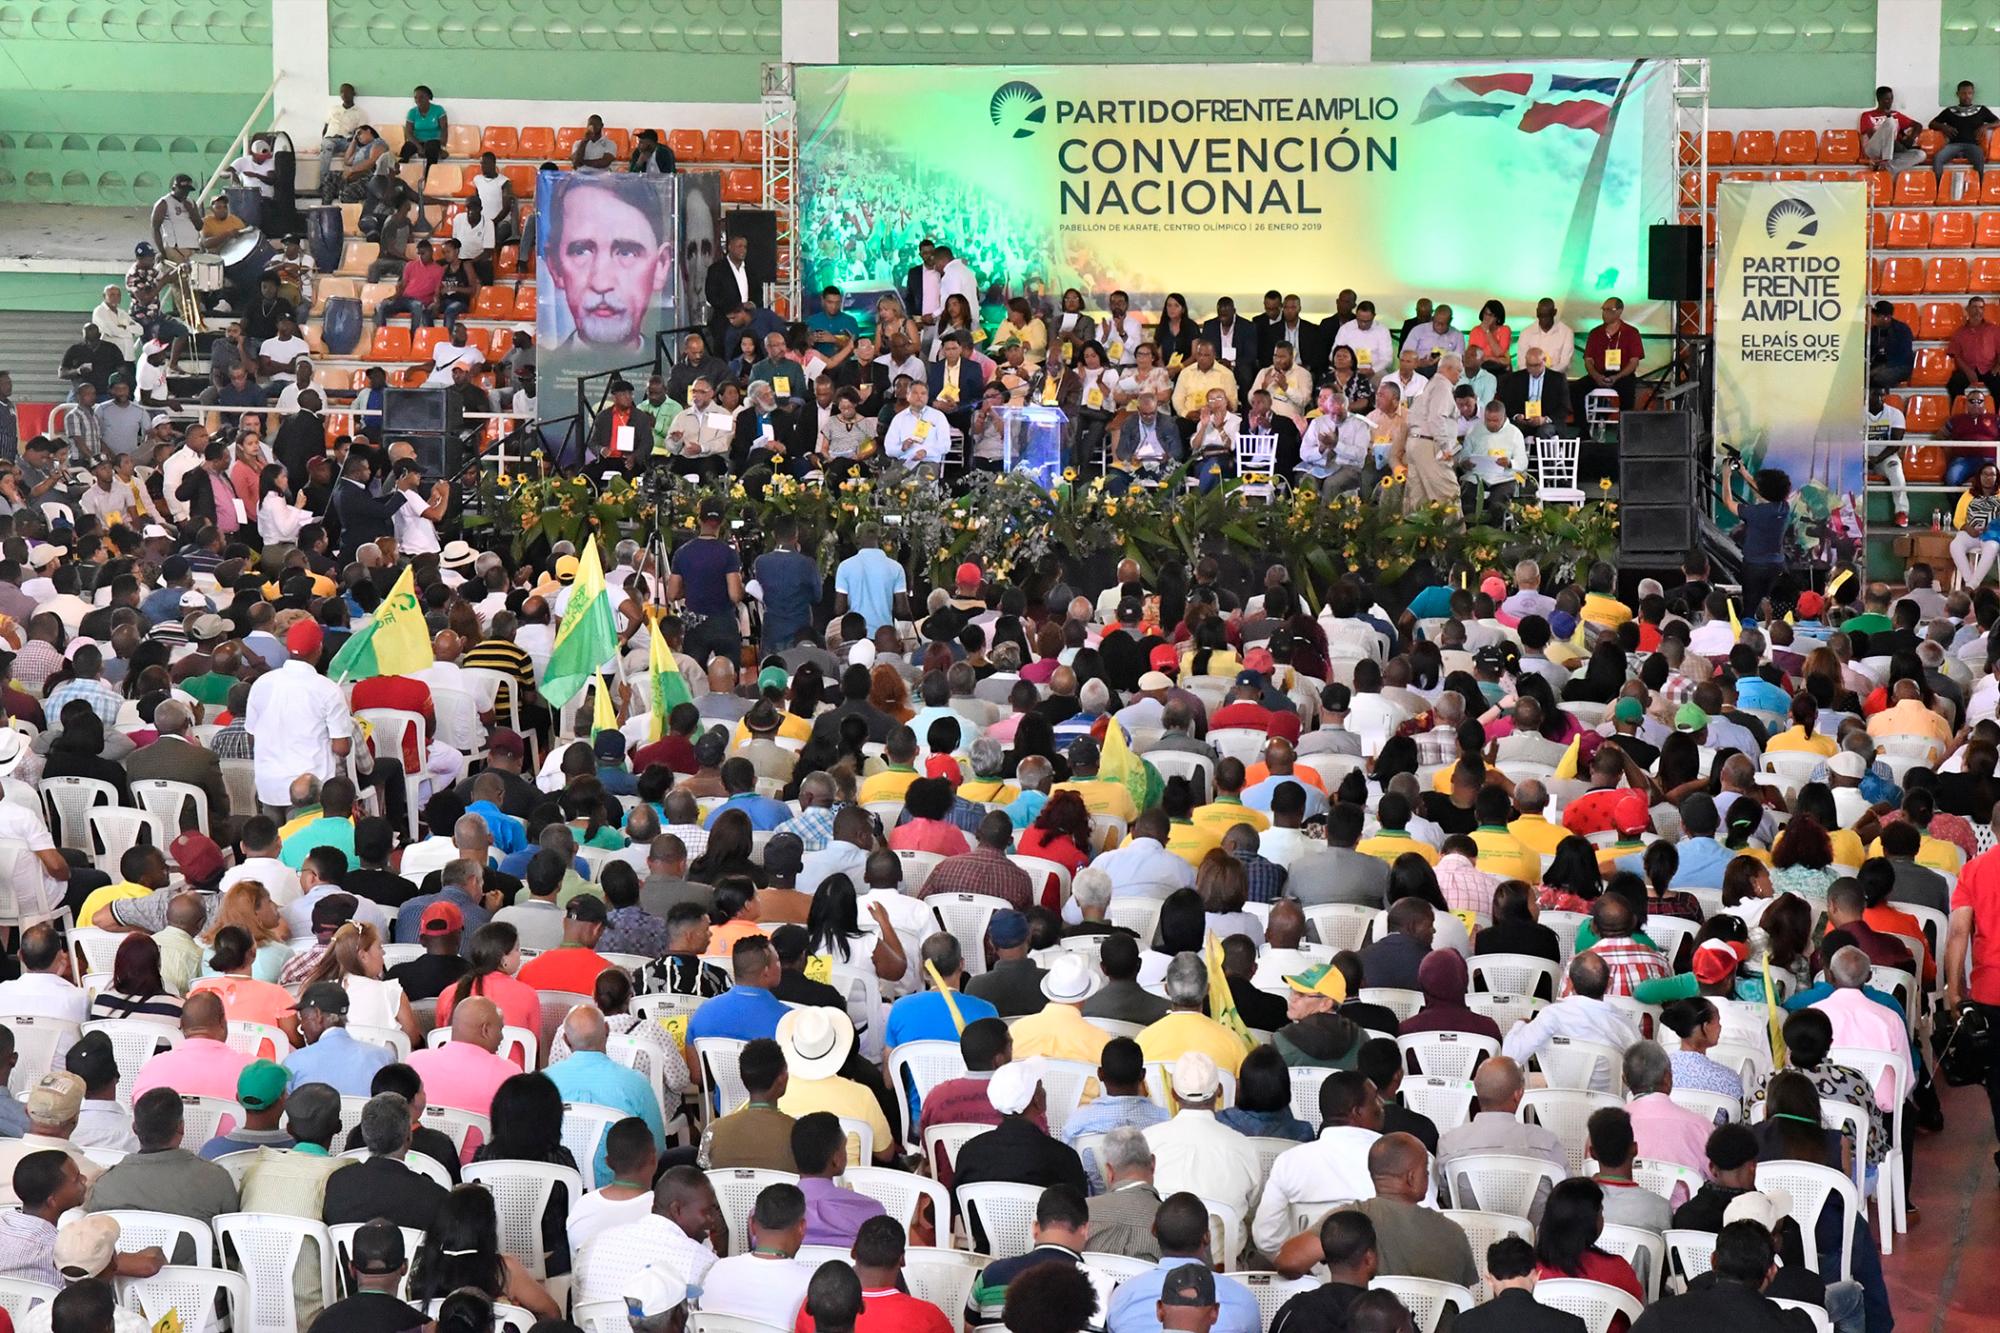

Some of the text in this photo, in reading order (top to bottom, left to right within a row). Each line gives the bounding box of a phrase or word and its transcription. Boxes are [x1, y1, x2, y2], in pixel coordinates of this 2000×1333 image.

[1057, 126, 1397, 174] CONVENCIÓN
[1059, 179, 1323, 215] NACIONAL
[1059, 221, 1323, 233] PABELLÓN DE KARATE, CENTRO OLÍMPICO 26 ENERO 2019
[1743, 256, 1840, 273] PARTIDO
[1743, 275, 1840, 298] FRENTE
[1741, 299, 1842, 322] AMPLIO
[1802, 334, 1840, 348] QUE
